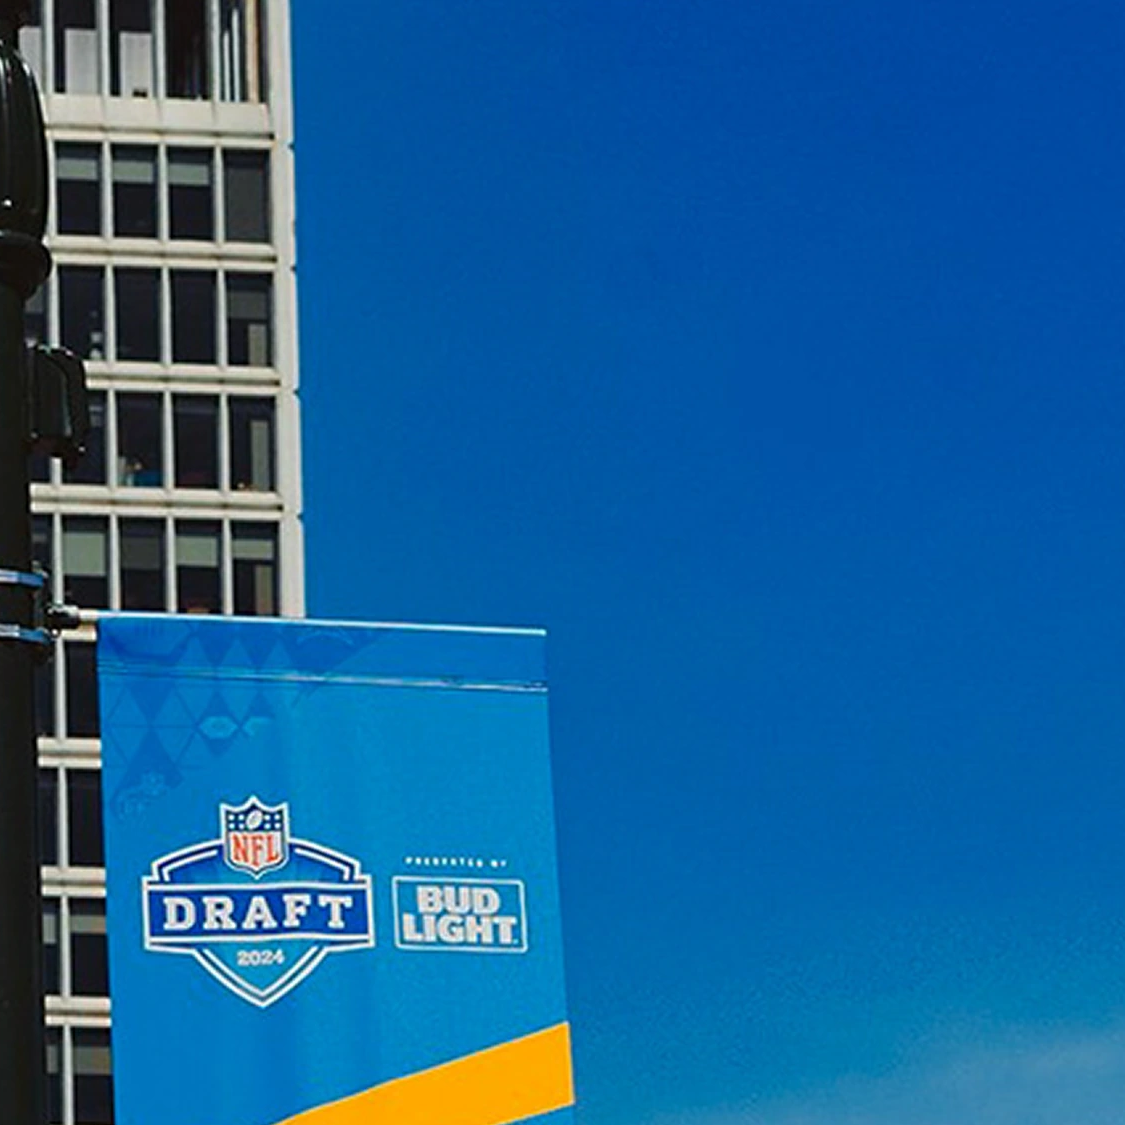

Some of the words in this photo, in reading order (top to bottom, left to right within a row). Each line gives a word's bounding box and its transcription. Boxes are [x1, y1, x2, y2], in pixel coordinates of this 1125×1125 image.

[232, 834, 279, 867] NFL
[162, 893, 353, 931] DRAFT
[416, 885, 500, 914] BUD
[402, 911, 517, 945] LIGHT
[236, 949, 286, 967] 2024
